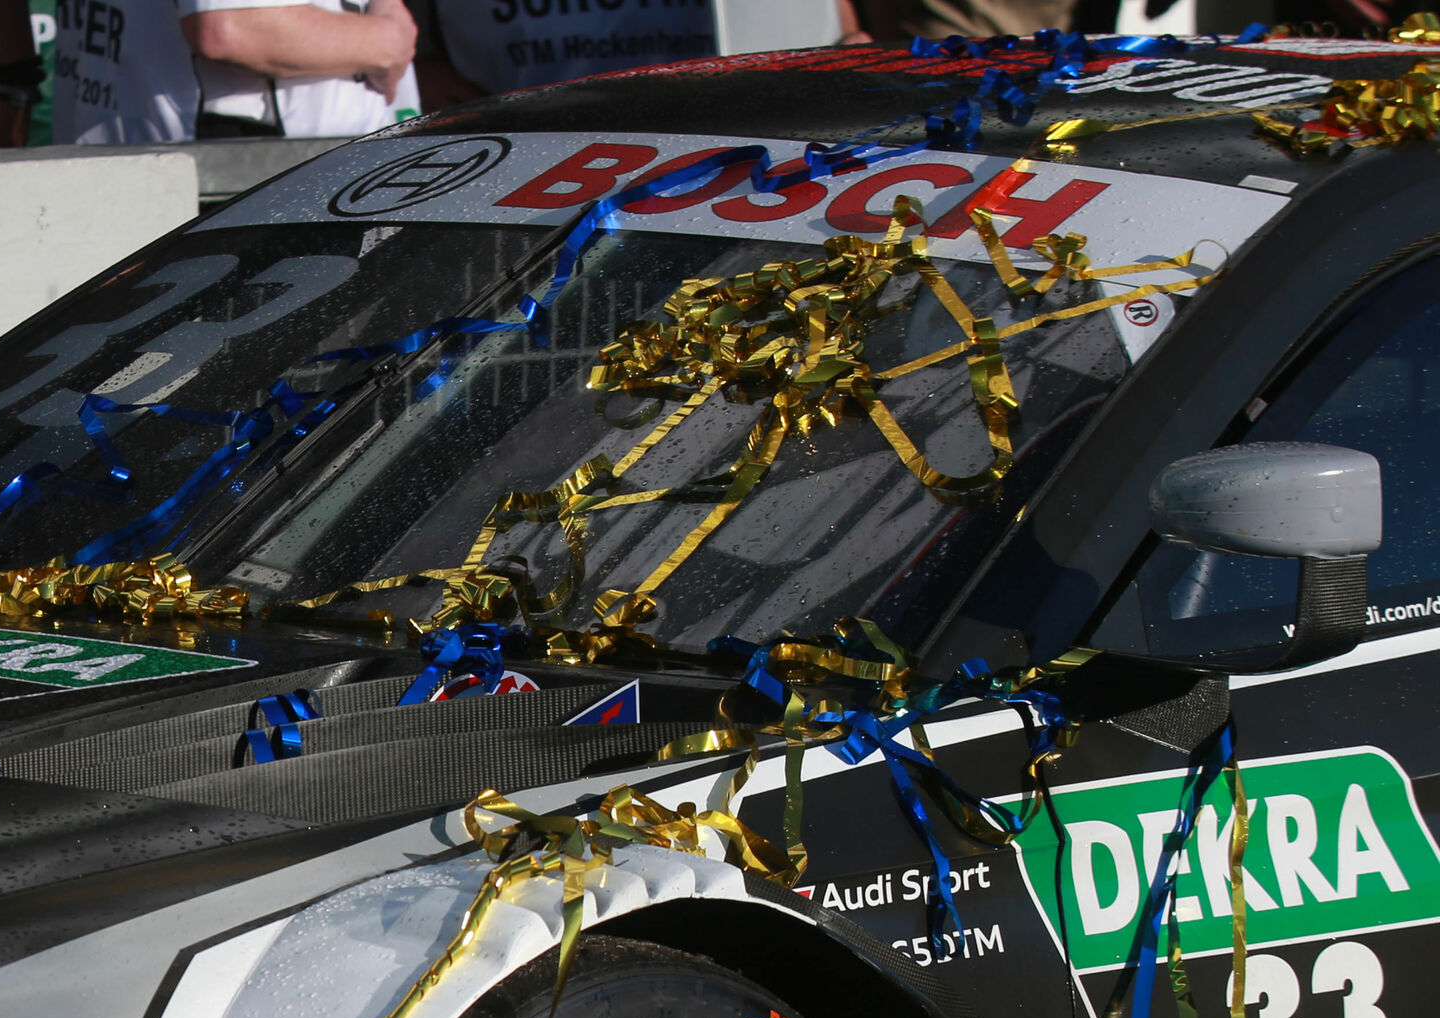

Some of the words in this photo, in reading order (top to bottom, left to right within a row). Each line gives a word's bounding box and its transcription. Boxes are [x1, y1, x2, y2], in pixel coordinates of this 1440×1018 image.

[496, 142, 1109, 251] BOSCH
[822, 873, 894, 912] Audi
[1063, 783, 1412, 937] DEKRA
